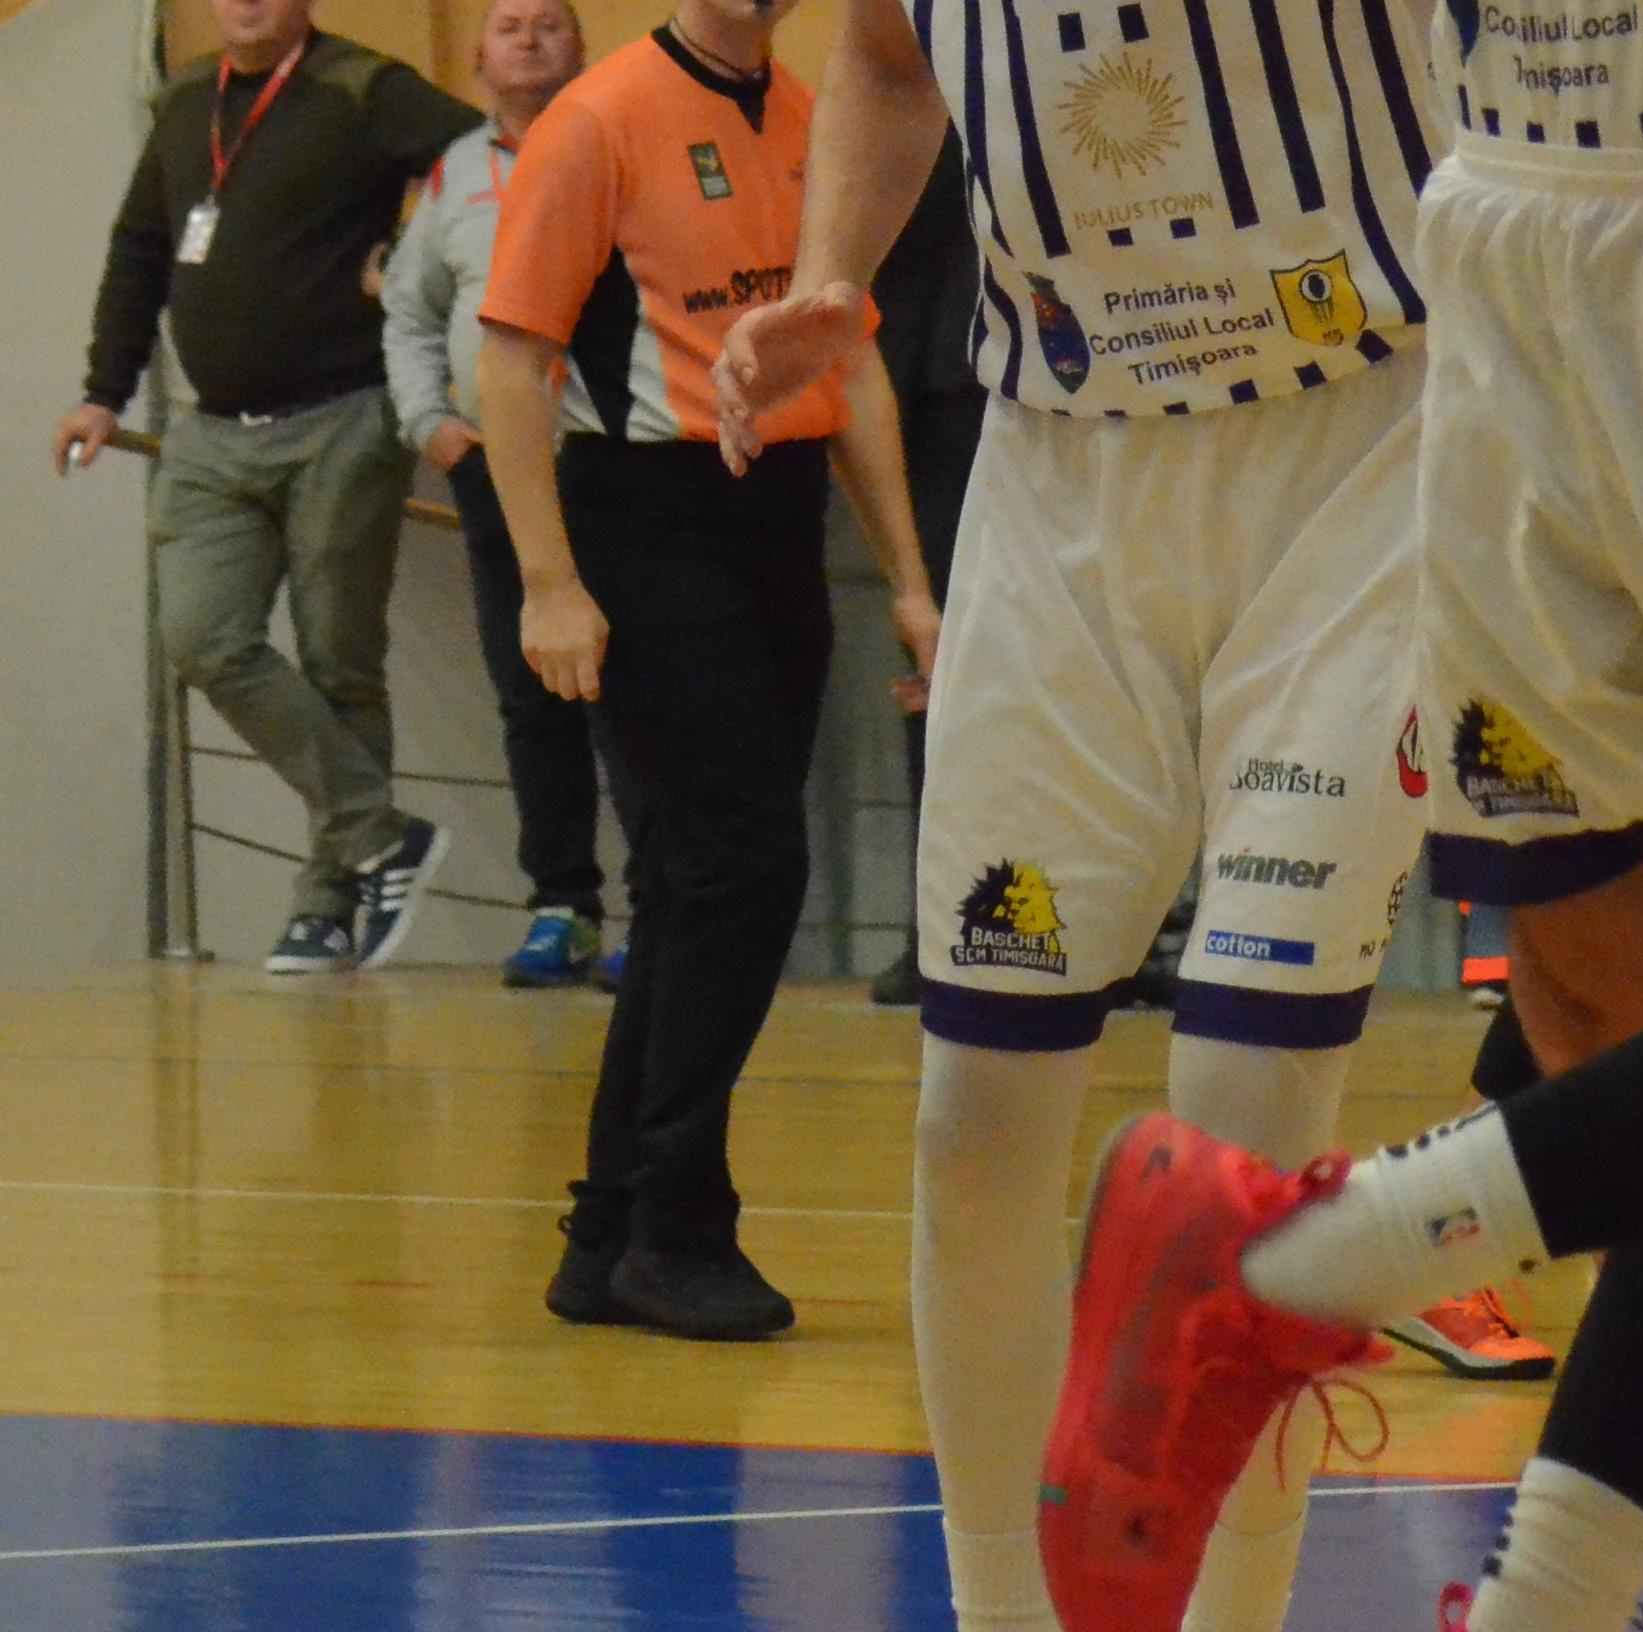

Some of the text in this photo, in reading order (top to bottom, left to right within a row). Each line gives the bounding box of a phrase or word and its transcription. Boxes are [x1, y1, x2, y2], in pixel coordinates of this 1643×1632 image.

[1104, 281, 1209, 316] Primăria
[1088, 307, 1277, 356] Consiliul Local
[1127, 342, 1259, 386] Timișoara
[1216, 846, 1338, 890] winner
[954, 945, 988, 964] SCM
[970, 926, 1051, 951] BASCHET
[1206, 933, 1272, 958] cotton
